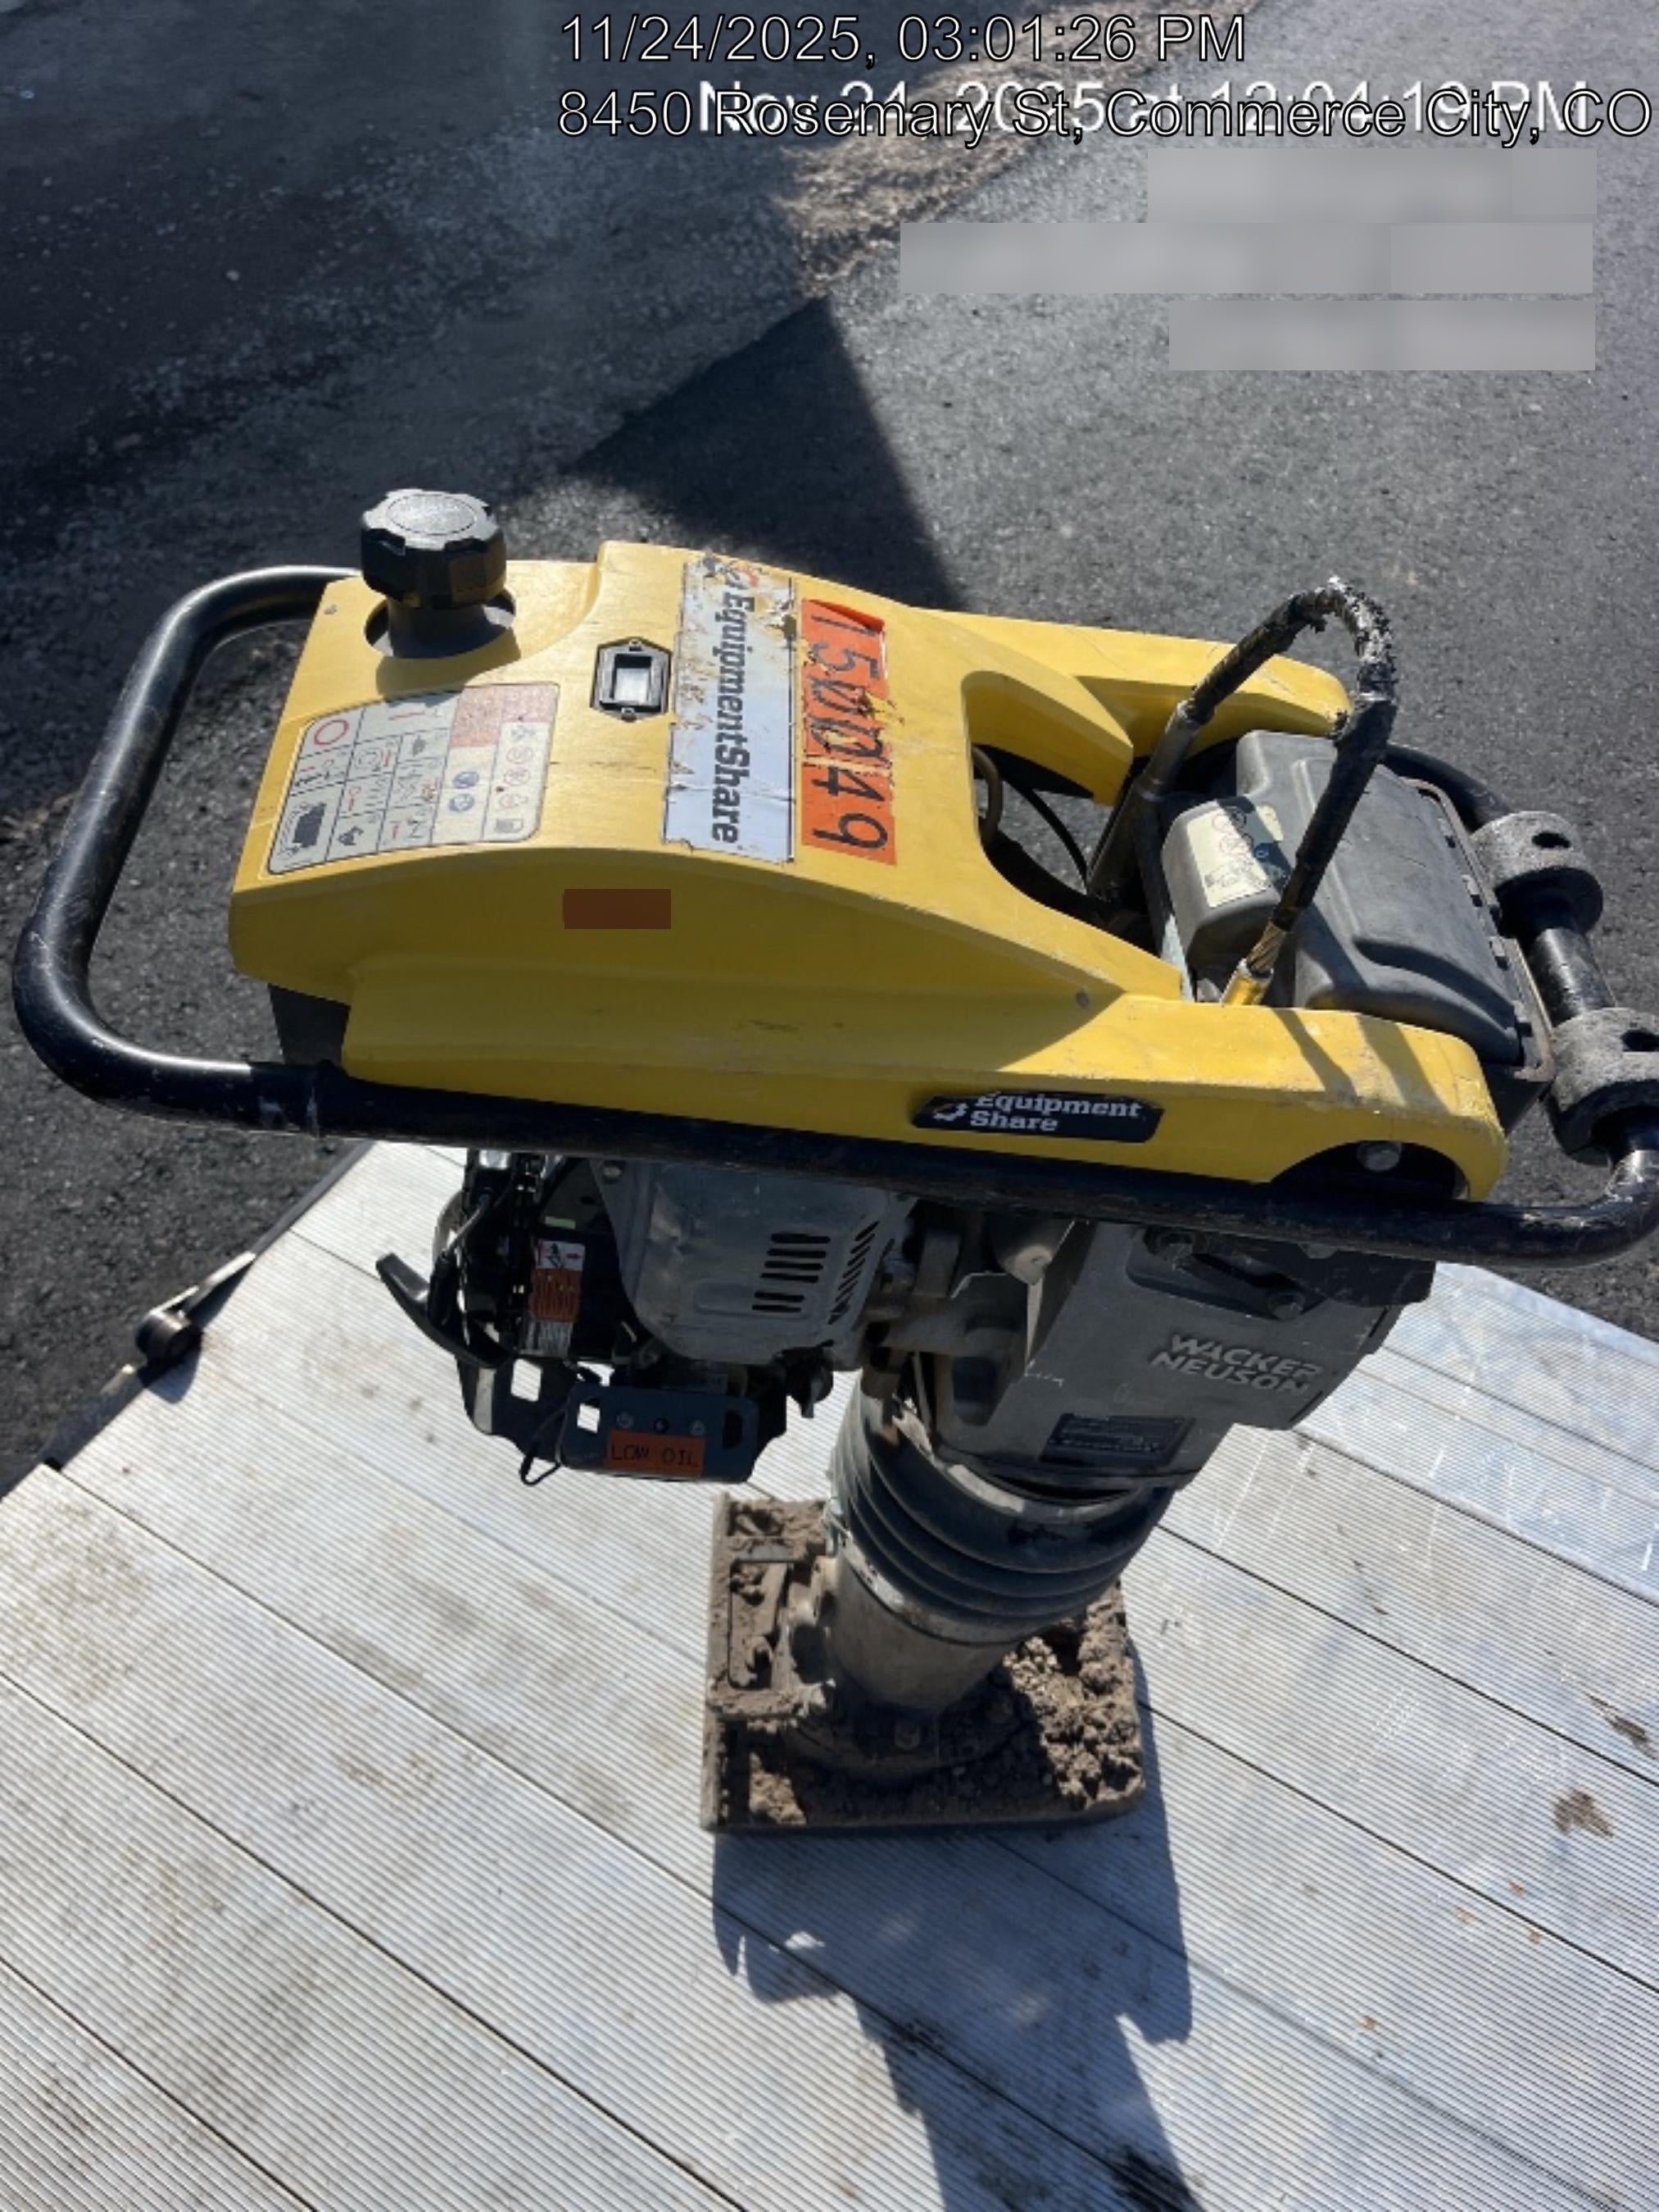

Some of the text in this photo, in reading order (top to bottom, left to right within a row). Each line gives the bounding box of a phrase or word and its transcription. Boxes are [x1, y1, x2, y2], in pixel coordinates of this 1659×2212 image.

[711, 591, 755, 845] EquipmentShare
[970, 1109, 1058, 1132] Share
[975, 1090, 1142, 1117] Equipment
[1169, 1333, 1325, 1378] WACKER
[1149, 1352, 1312, 1394] NEUSON
[611, 1443, 700, 1468] LOW OIL
